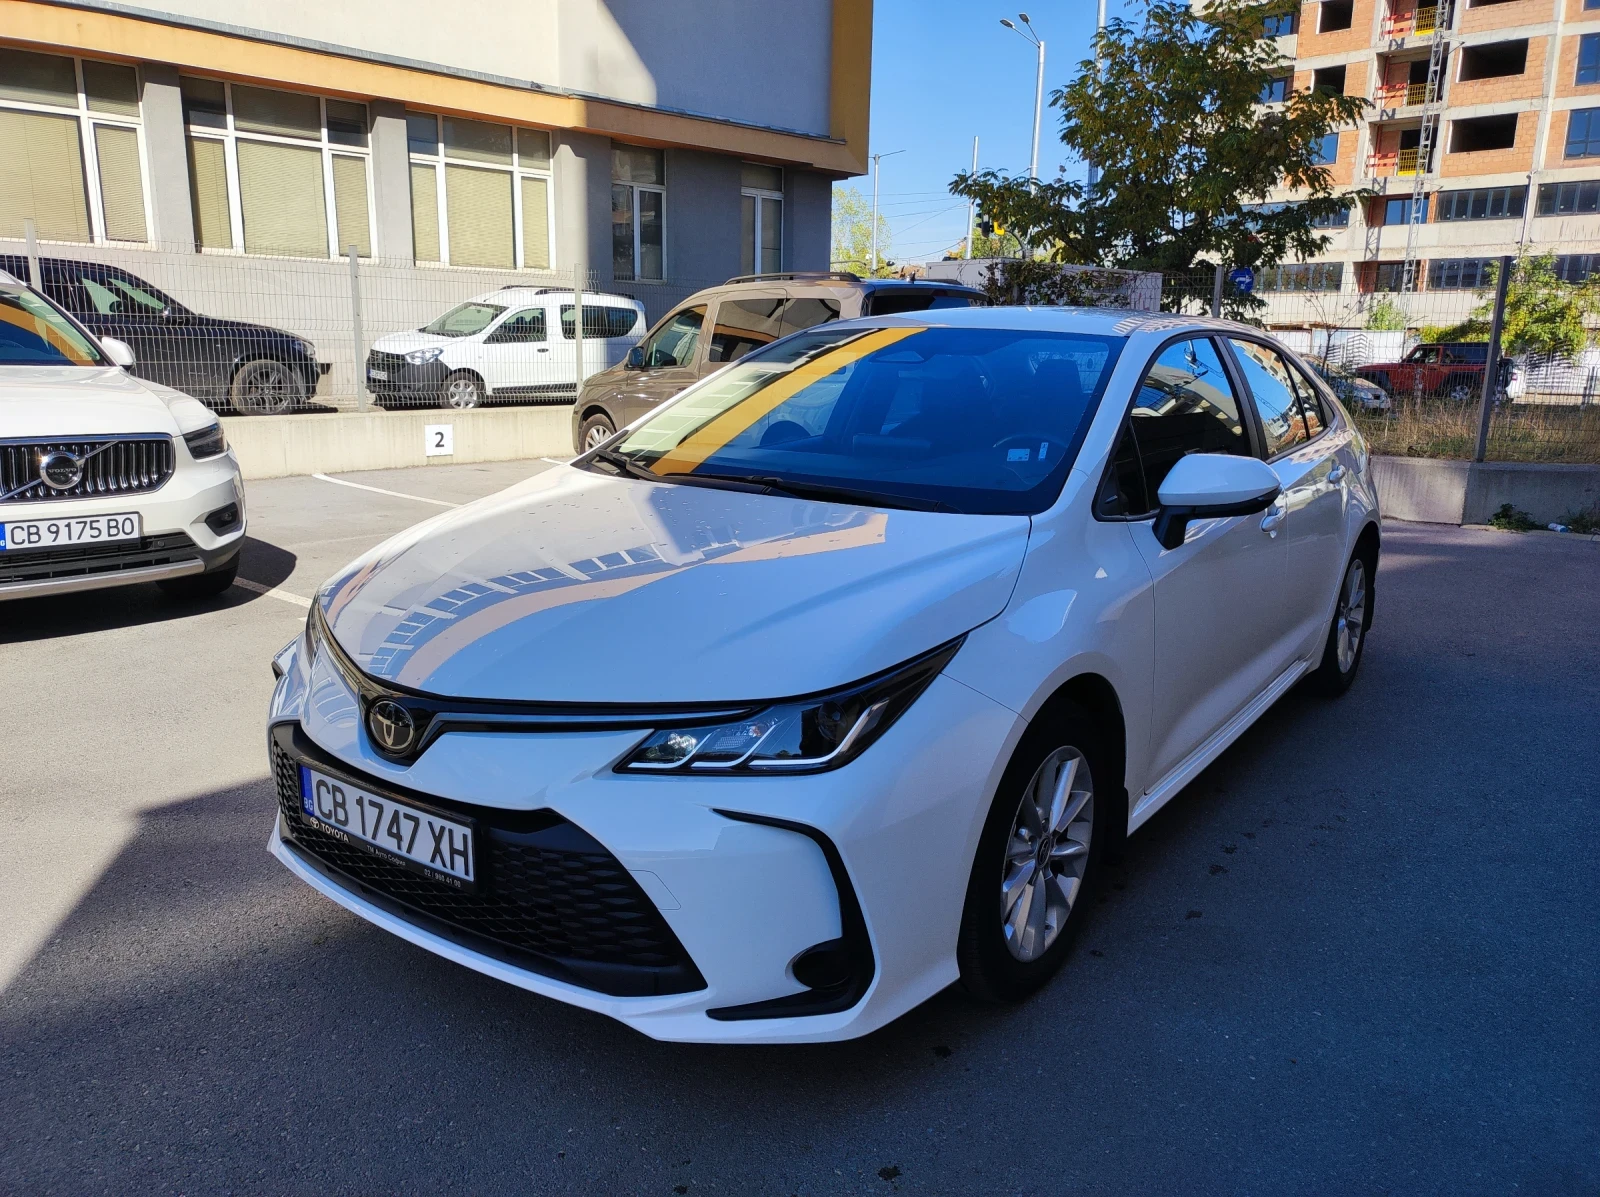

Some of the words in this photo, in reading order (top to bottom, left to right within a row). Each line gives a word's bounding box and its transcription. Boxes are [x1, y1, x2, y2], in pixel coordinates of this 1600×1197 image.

[434, 431, 445, 448] 2
[10, 525, 41, 546] CB
[47, 520, 102, 542] 9175
[107, 517, 135, 538] BO
[303, 797, 314, 811] BG
[315, 779, 349, 828] CB
[355, 795, 420, 855] 1747
[427, 820, 470, 877] XH
[320, 822, 350, 842] TOYOTA
